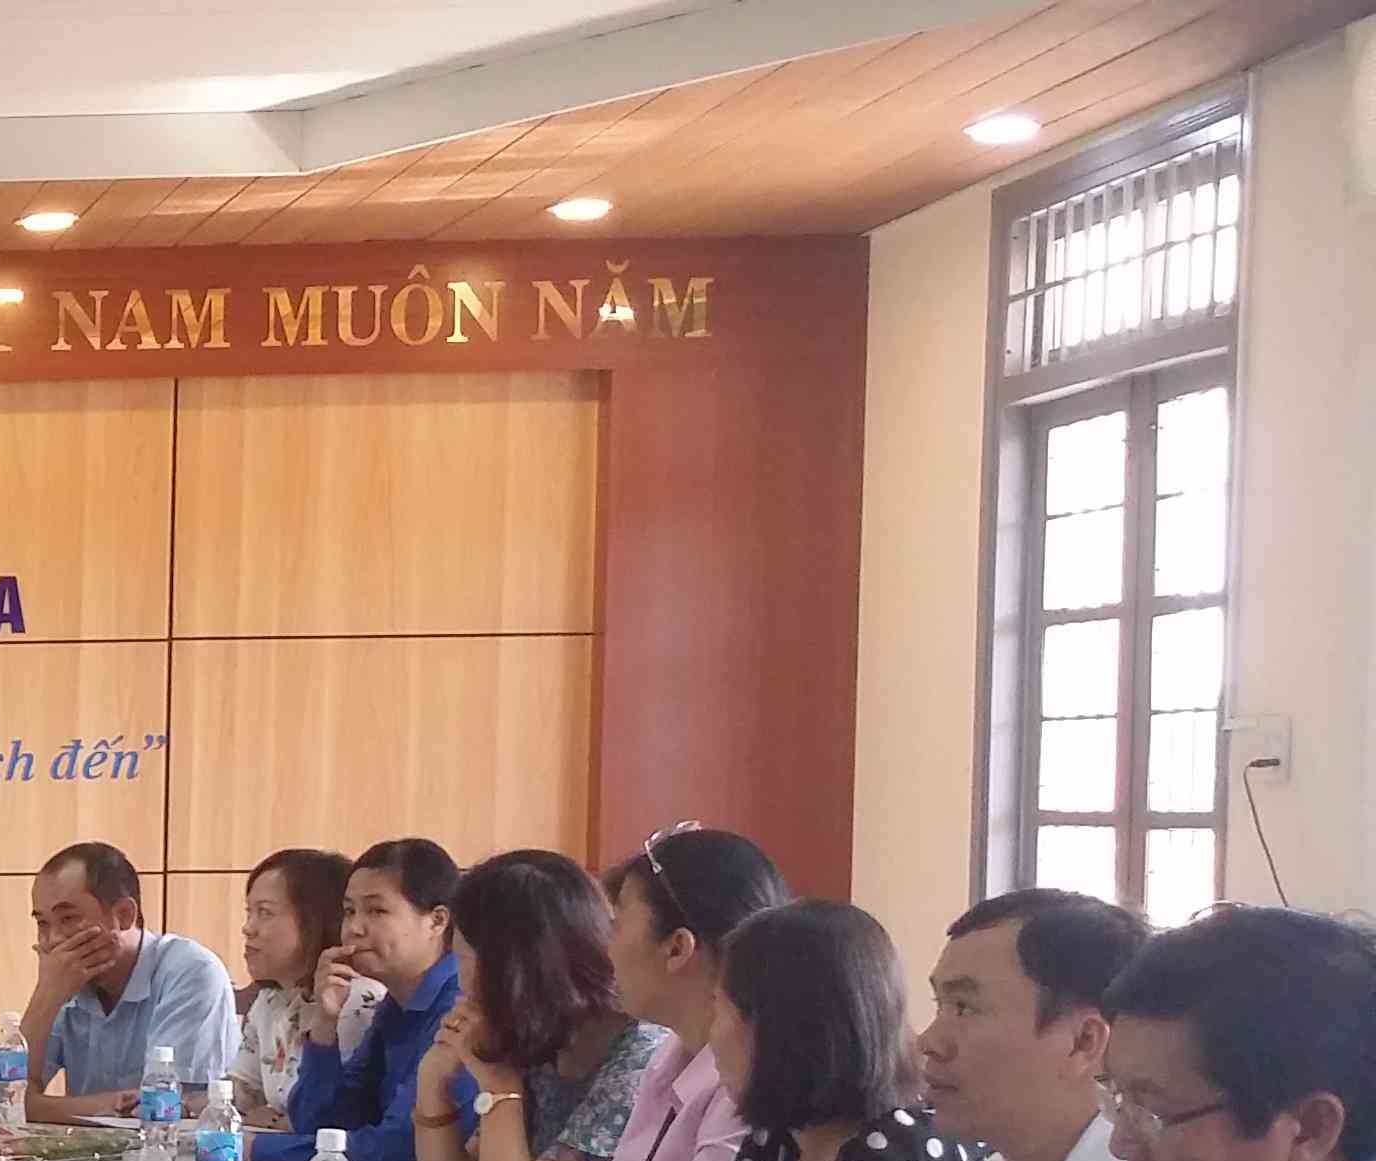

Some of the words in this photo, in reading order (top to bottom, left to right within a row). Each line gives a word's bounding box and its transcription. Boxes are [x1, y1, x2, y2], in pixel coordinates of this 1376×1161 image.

[50, 288, 232, 352] NAM
[262, 264, 505, 347] MUÔN
[531, 259, 715, 341] NĂM
